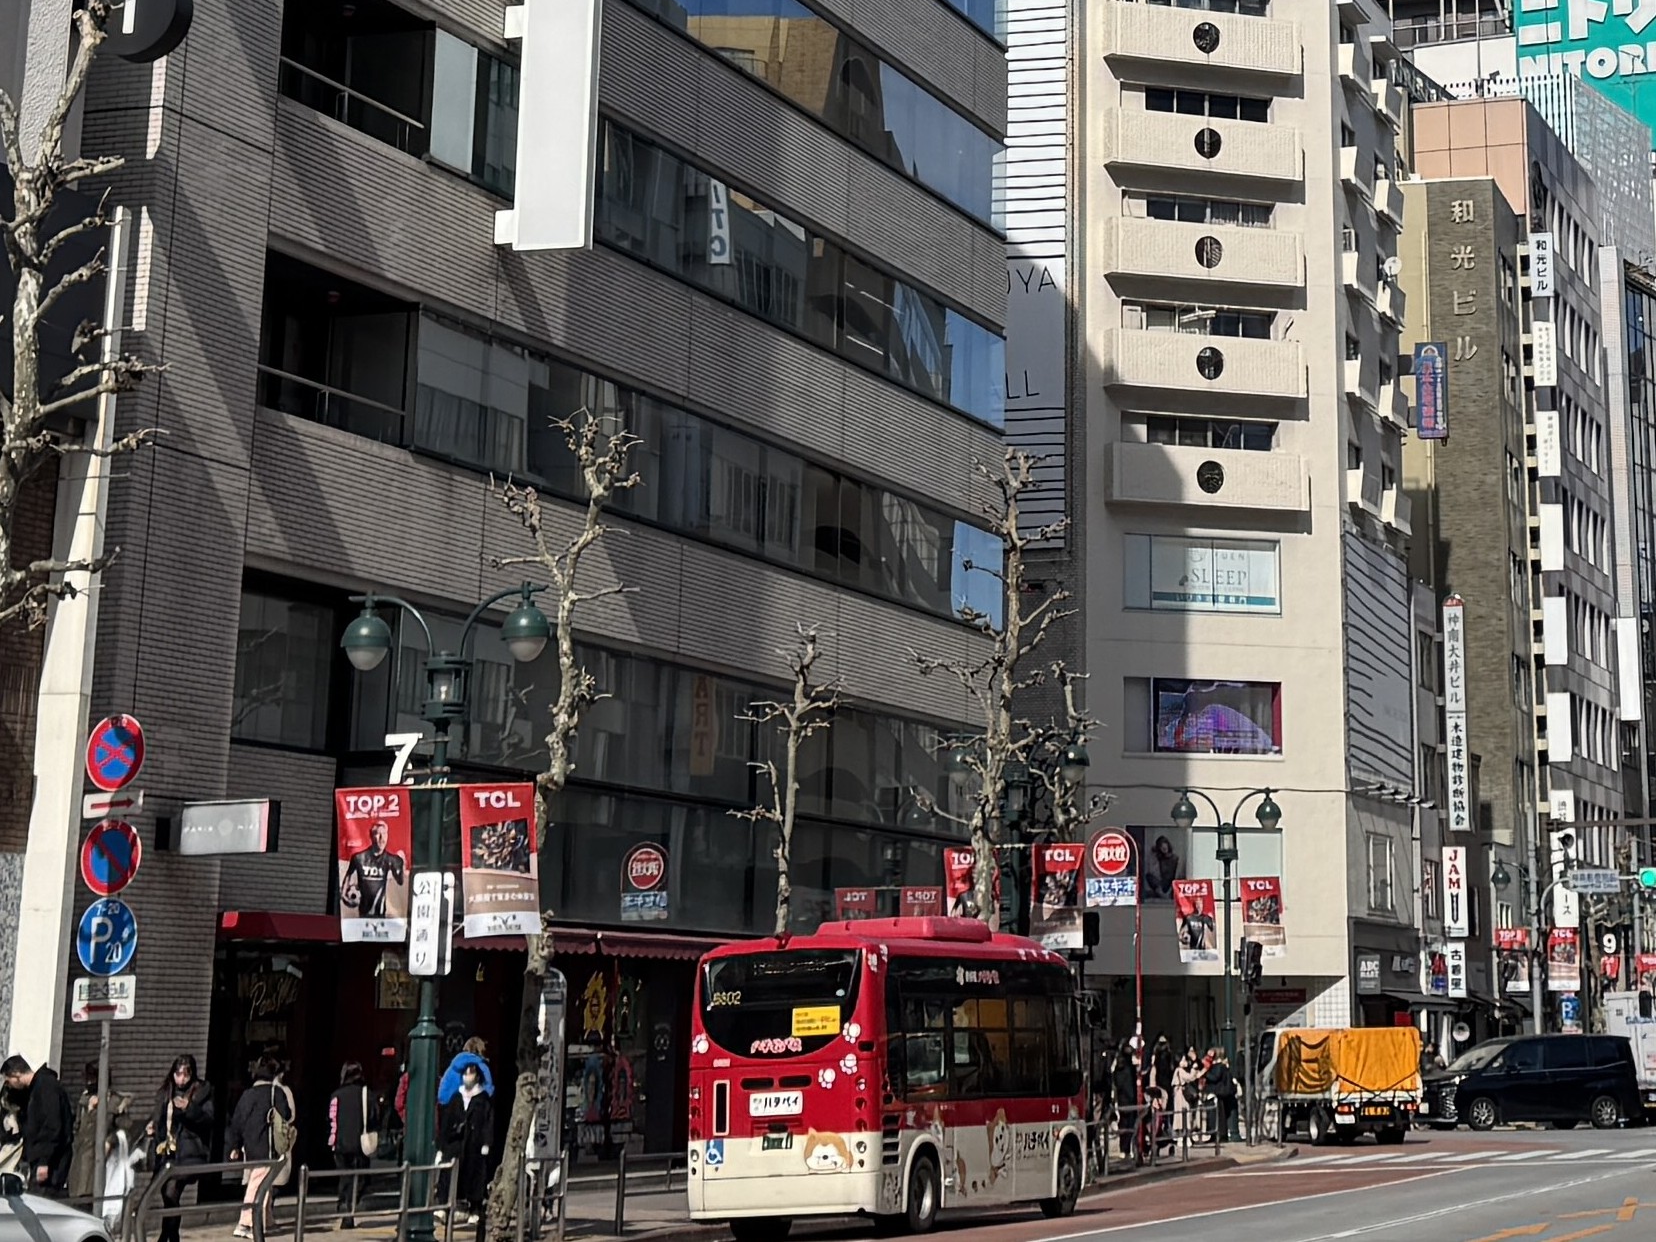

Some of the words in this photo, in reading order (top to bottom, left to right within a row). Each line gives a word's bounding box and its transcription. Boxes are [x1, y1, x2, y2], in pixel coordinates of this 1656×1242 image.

[1450, 199, 1478, 361] 和光ビル
[385, 732, 423, 785] 7
[346, 796, 386, 812] TOP
[388, 795, 399, 811] 2
[473, 791, 521, 808] TCL
[1044, 849, 1075, 862] TCL
[1448, 849, 1461, 890] JAM
[1178, 883, 1200, 894] TOP
[1247, 880, 1273, 890] TCL
[416, 880, 431, 966] 公園通り
[90, 917, 113, 964] P
[1552, 929, 1573, 938] TCL
[105, 942, 122, 963] 20
[1602, 933, 1617, 954] 9
[1360, 960, 1379, 972] ABC
